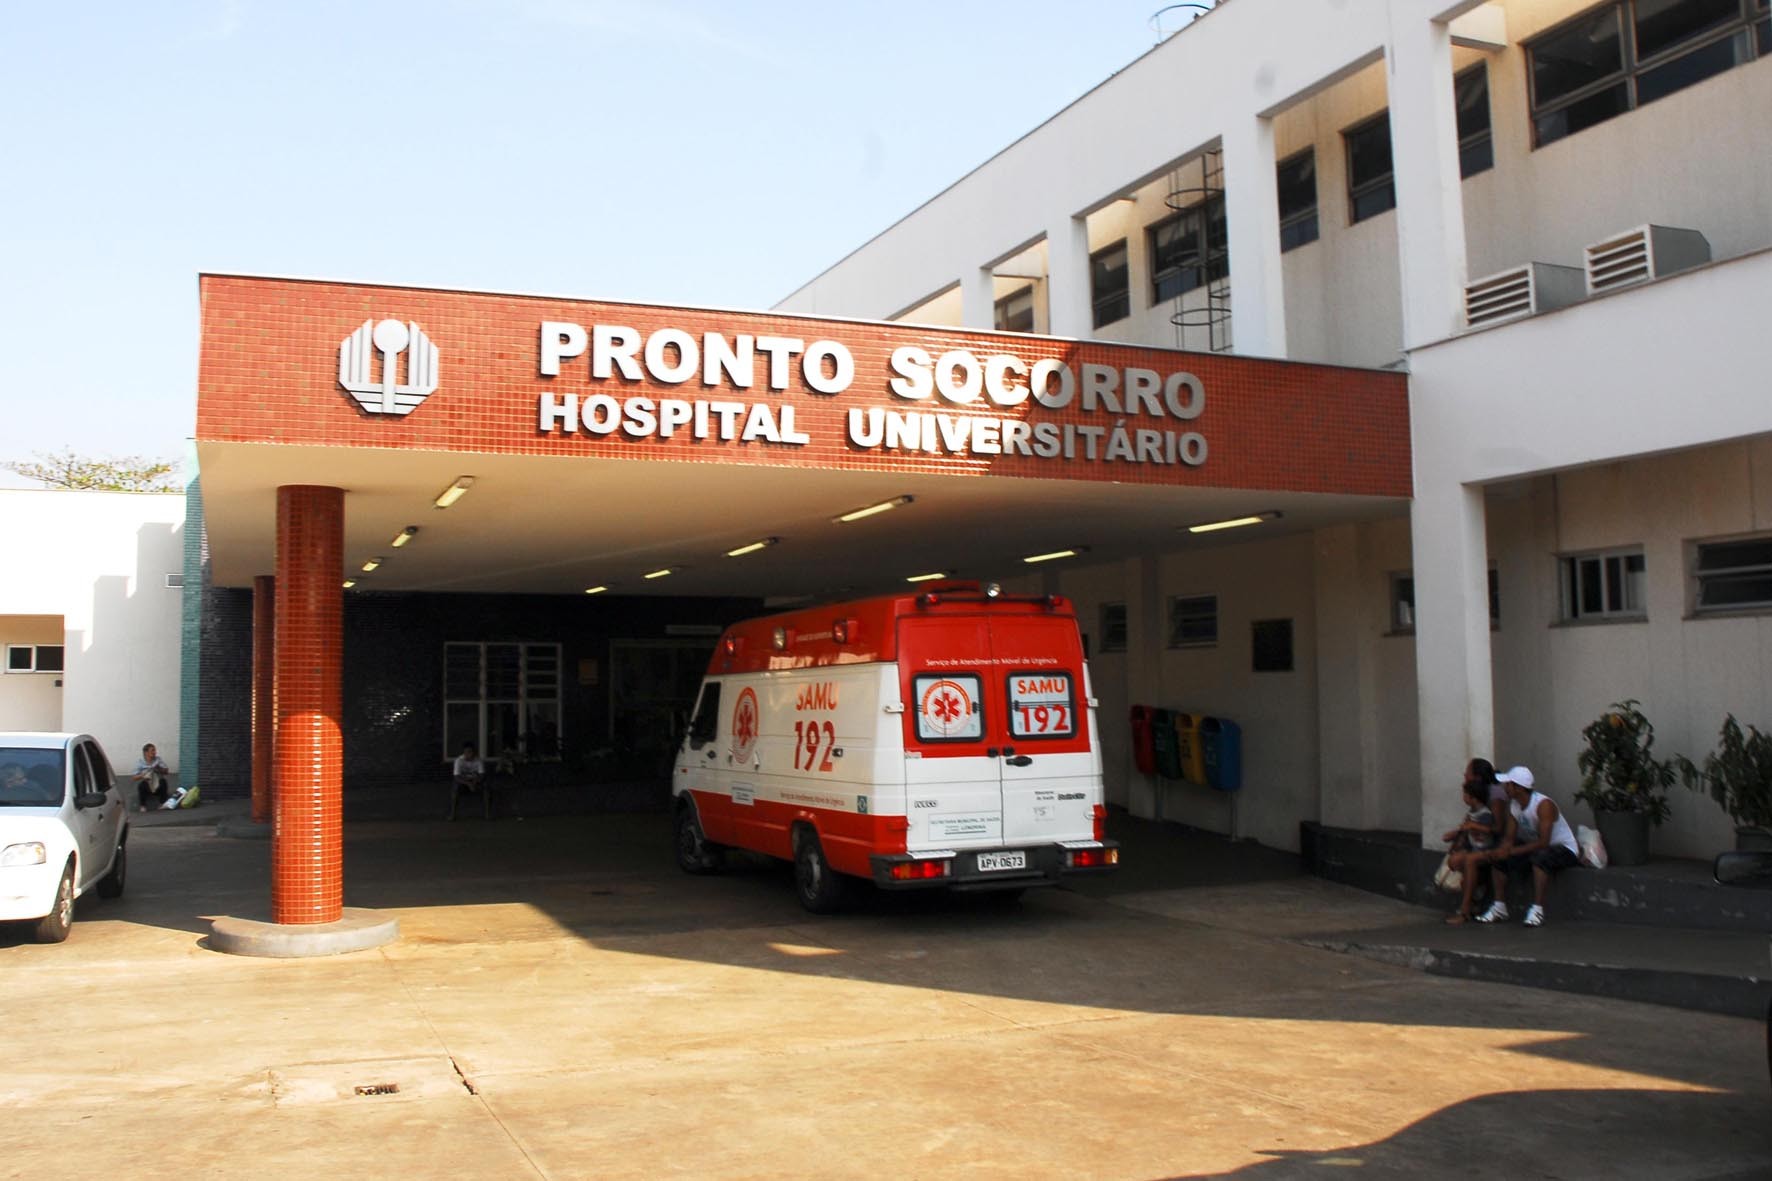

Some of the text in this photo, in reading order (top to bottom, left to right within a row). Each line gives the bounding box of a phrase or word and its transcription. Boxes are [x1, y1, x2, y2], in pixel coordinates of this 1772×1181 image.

[541, 320, 1206, 420] PRONTO SOCORRO
[540, 391, 1209, 466] HOSPITAL UNIVERSITÁRIO
[795, 681, 839, 711] SAMU
[1017, 677, 1066, 695] SAMU
[1019, 703, 1070, 733] 192
[793, 720, 835, 772] 192
